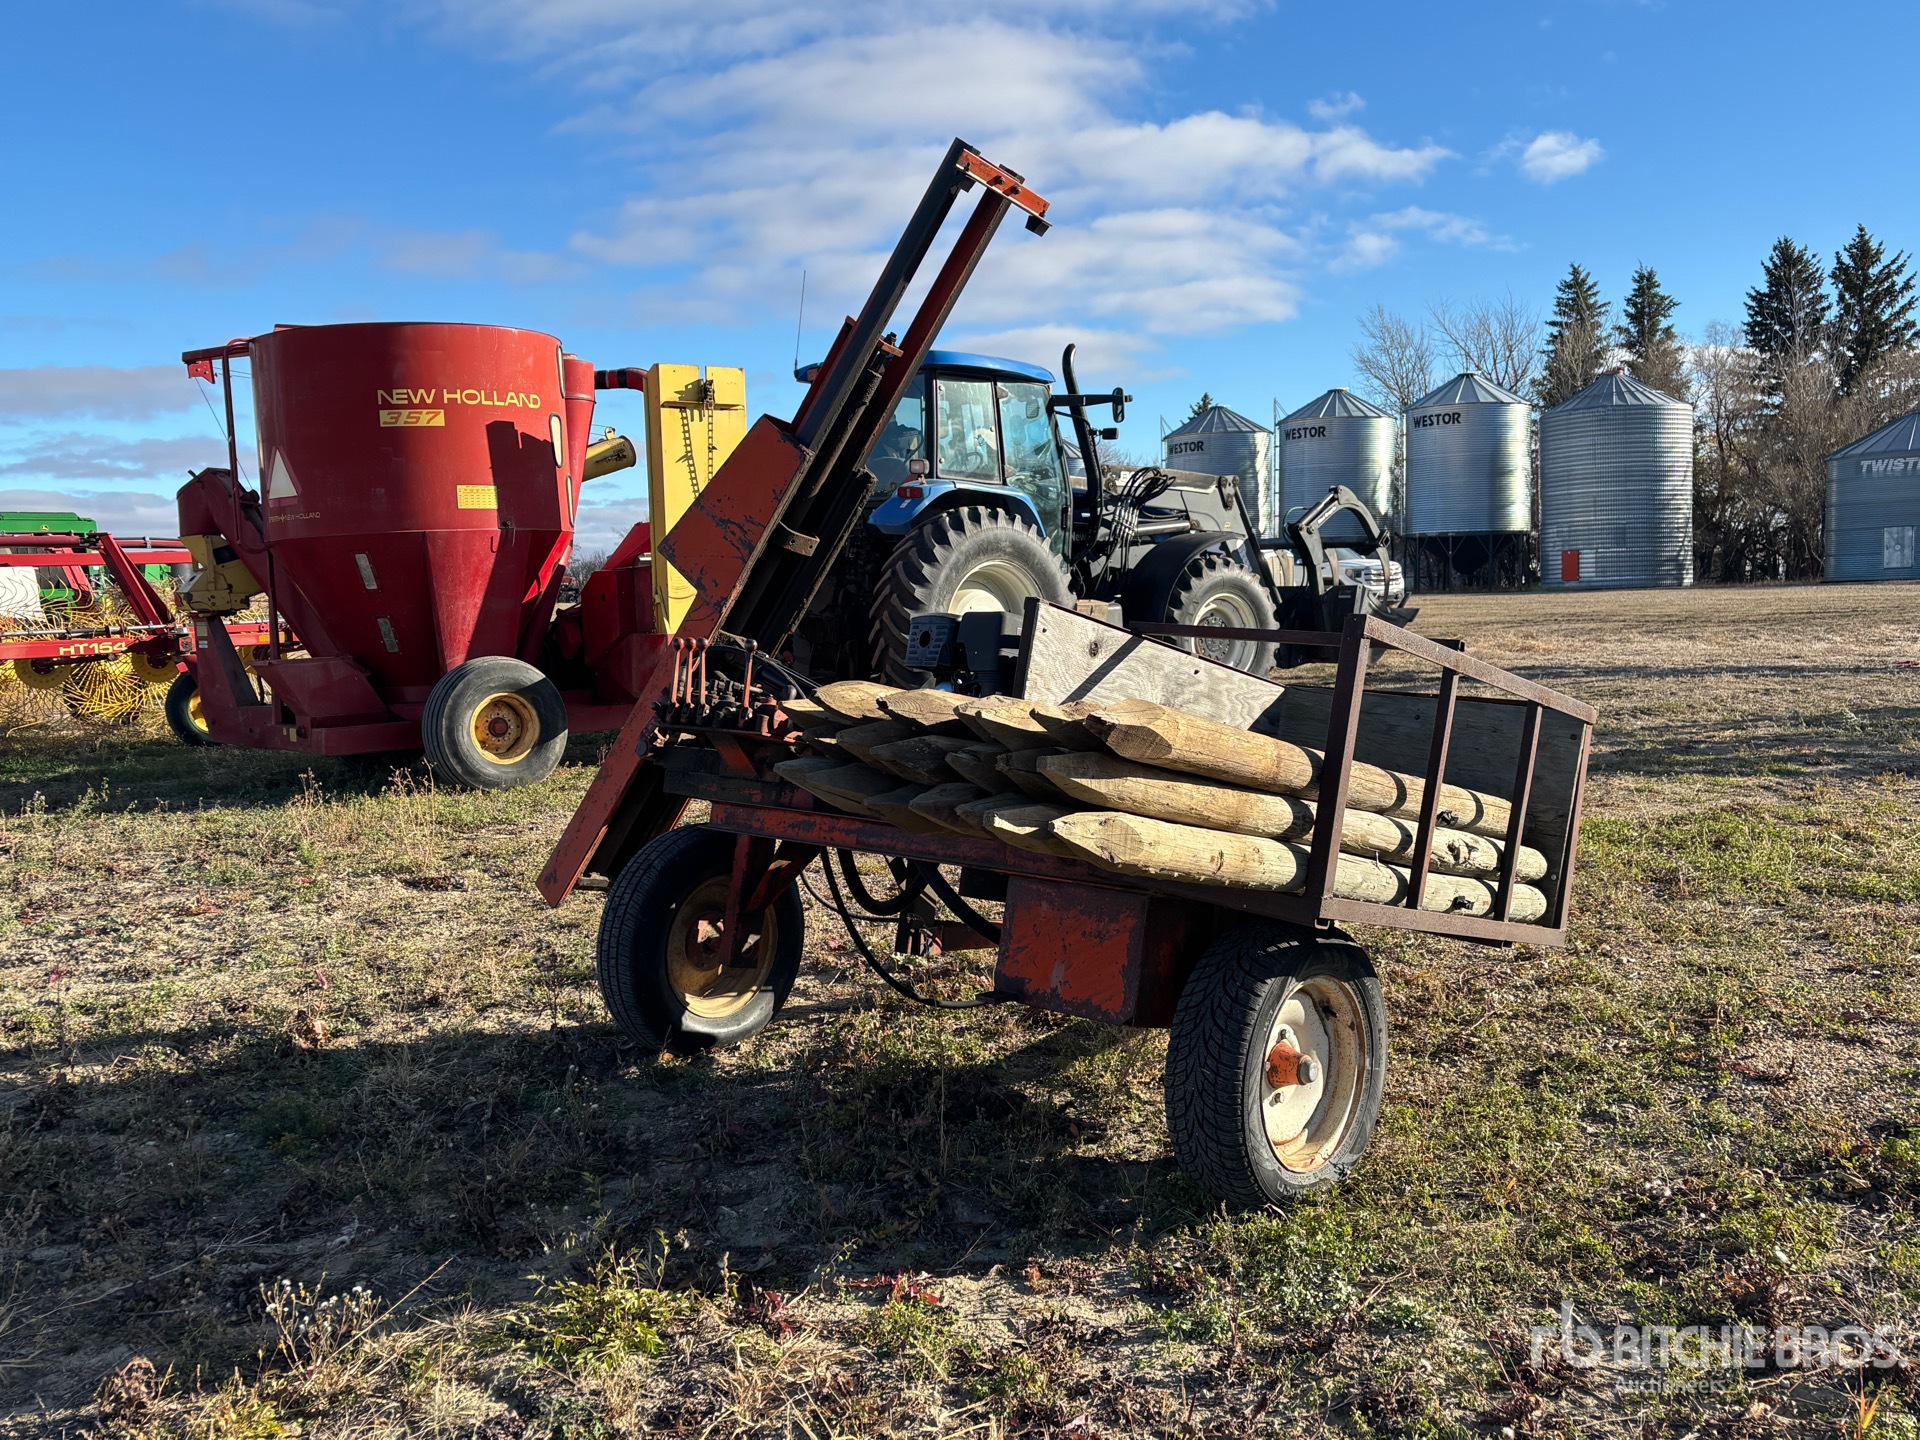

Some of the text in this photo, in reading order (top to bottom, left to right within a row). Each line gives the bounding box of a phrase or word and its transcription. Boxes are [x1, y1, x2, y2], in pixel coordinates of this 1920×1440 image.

[377, 388, 541, 409] NEW HOLLAND
[382, 411, 441, 425] 357
[1413, 412, 1462, 429] WESTOR
[1285, 426, 1327, 441] WESTOR
[1860, 457, 1920, 473] TWIST
[59, 641, 128, 656] HT154
